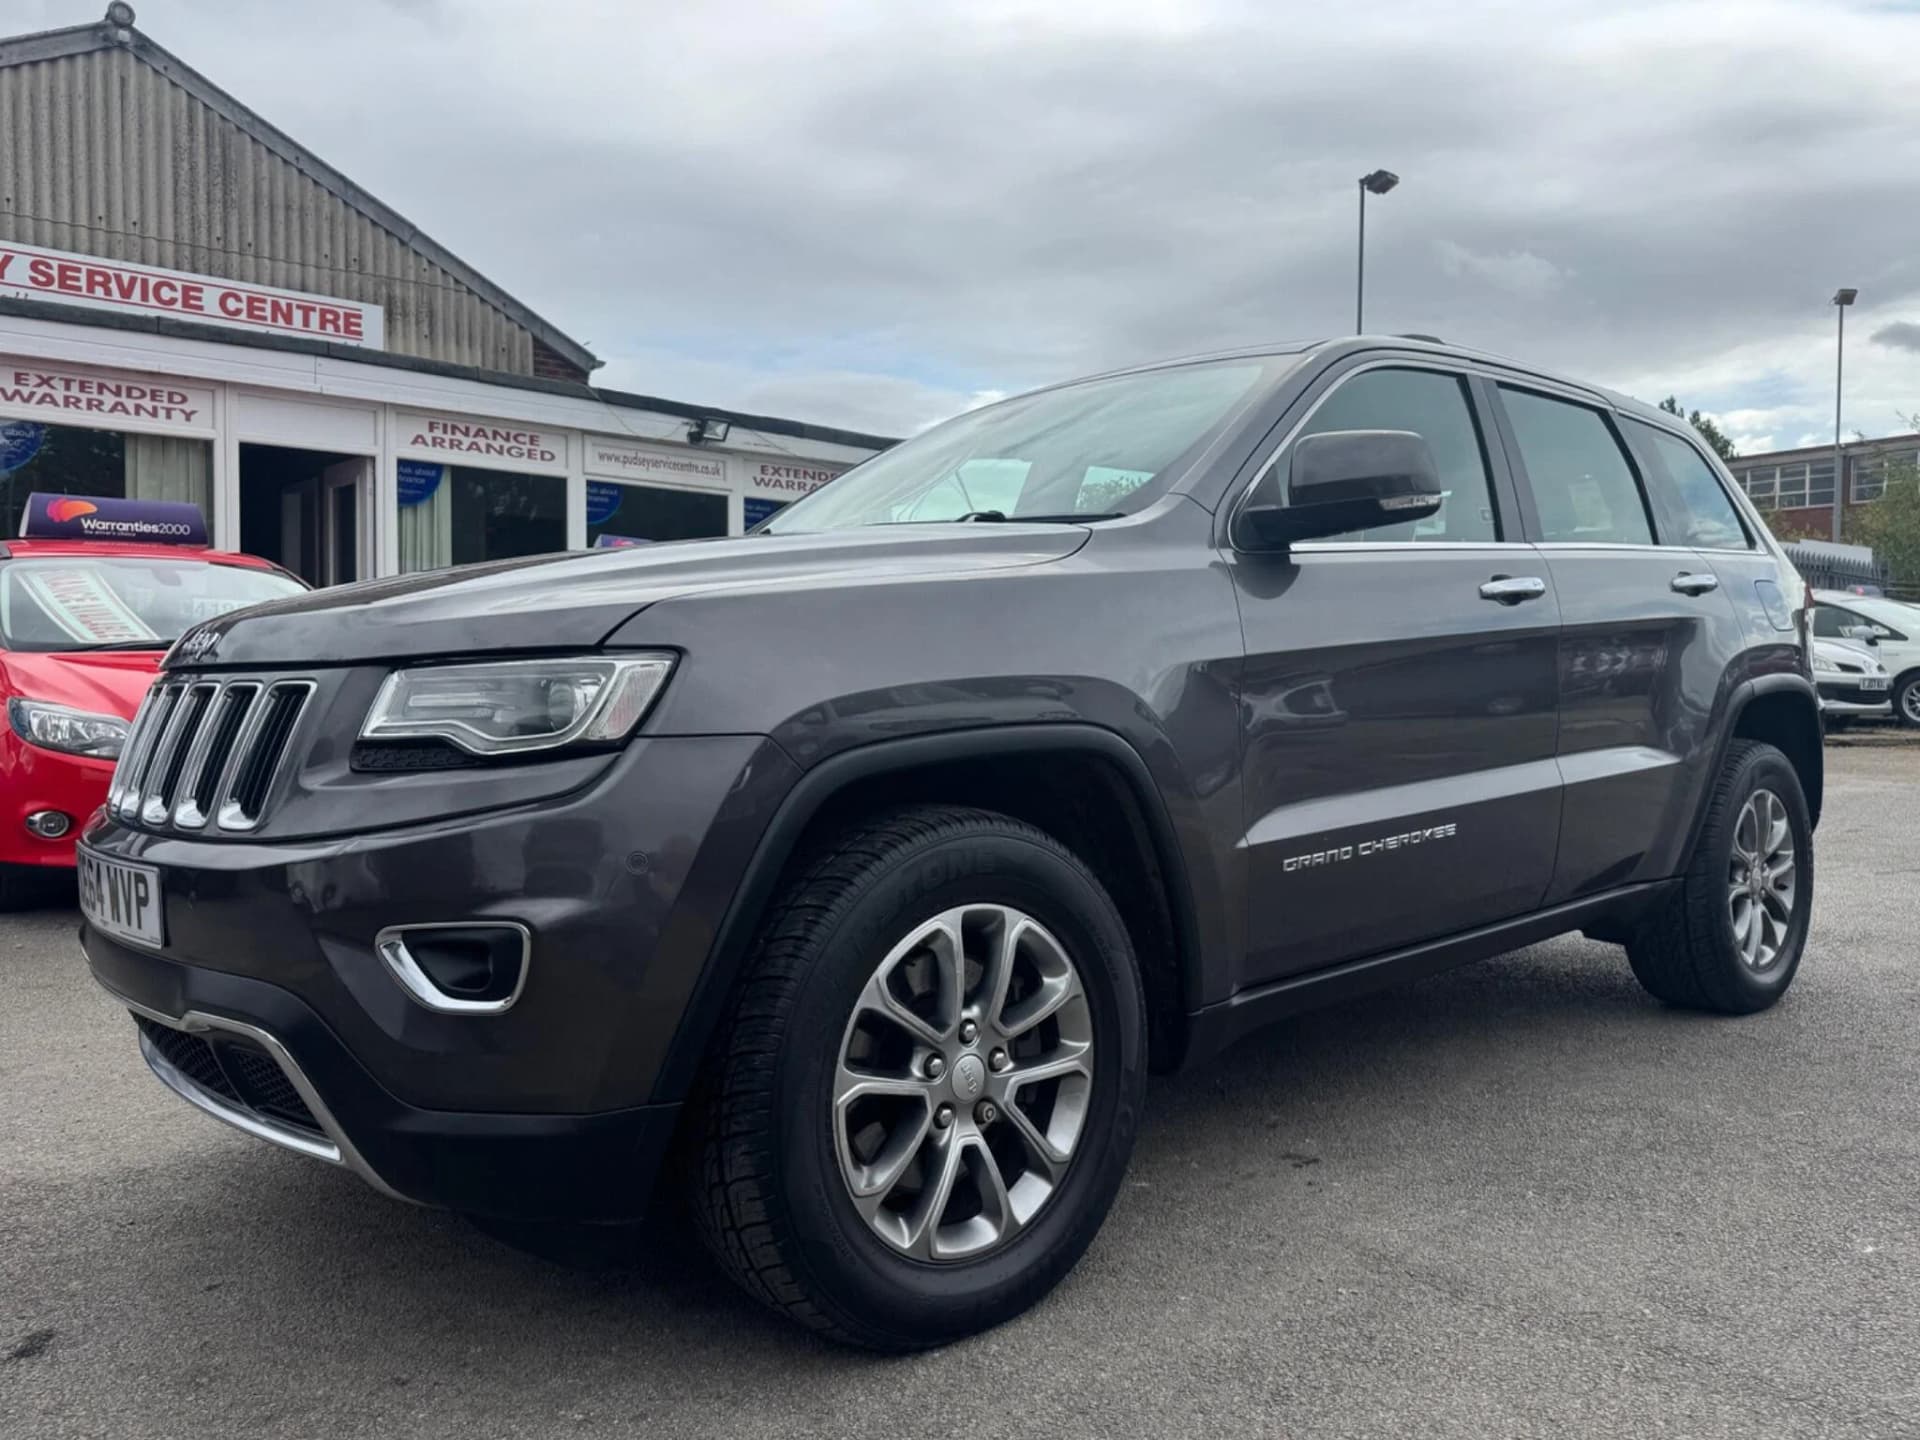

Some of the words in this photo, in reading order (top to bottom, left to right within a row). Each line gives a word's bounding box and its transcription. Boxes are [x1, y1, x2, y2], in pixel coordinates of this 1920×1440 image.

[28, 259, 205, 312] SERVICE
[218, 291, 363, 337] CENTRE
[0, 387, 199, 423] WARRANTY
[14, 371, 189, 406] EXTENDED
[410, 434, 556, 462] ARRANGED
[428, 421, 541, 447] FINANCE
[752, 475, 819, 491] WARRA
[1283, 846, 1353, 872] GRAND
[1357, 823, 1457, 856] CHEROKEE
